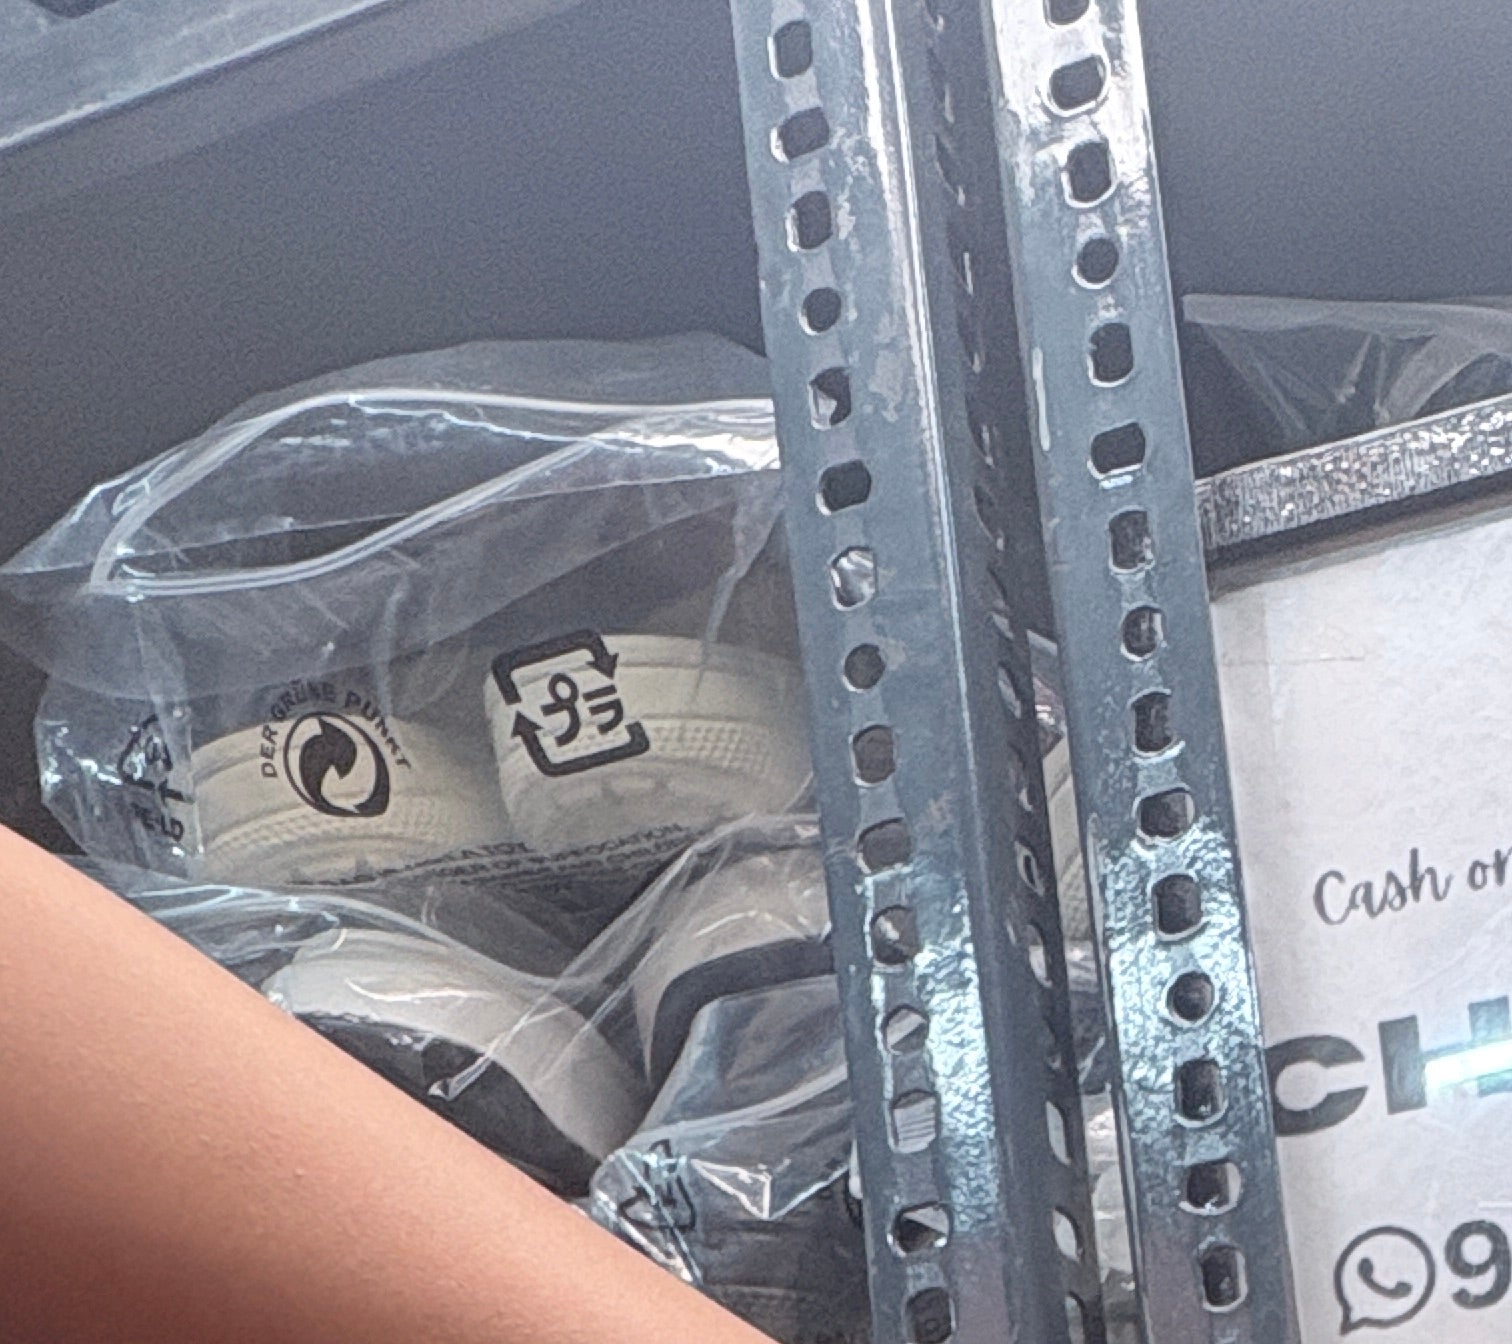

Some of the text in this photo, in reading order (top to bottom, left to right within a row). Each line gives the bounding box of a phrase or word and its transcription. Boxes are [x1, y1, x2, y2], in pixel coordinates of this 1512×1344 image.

[260, 725, 278, 778] DER
[344, 690, 412, 769] PUNKT
[541, 672, 624, 747] プラ
[1312, 847, 1455, 926] Cash
